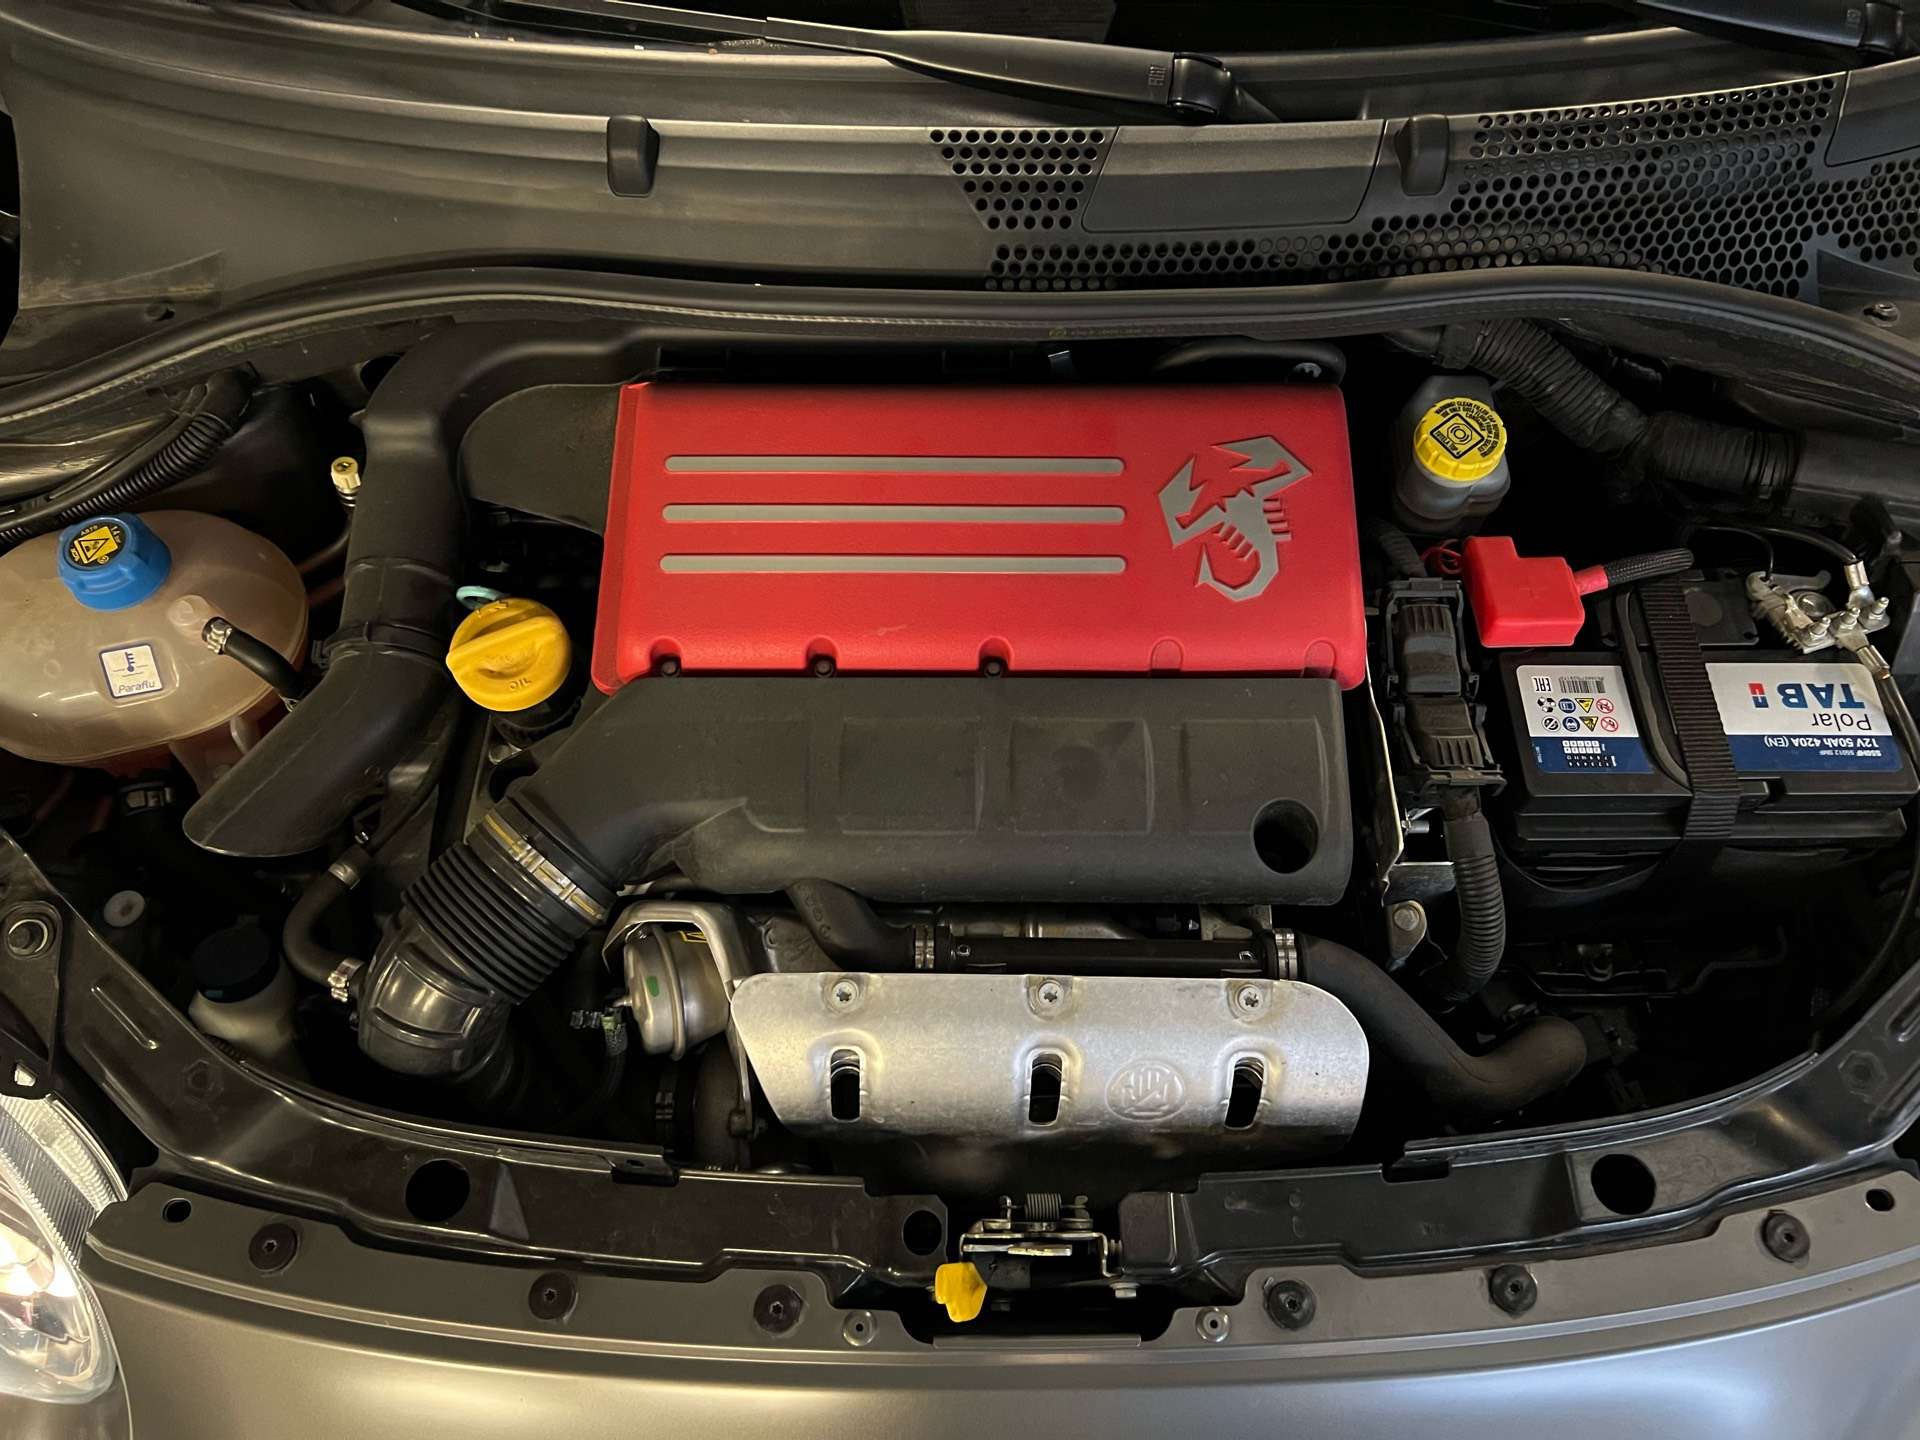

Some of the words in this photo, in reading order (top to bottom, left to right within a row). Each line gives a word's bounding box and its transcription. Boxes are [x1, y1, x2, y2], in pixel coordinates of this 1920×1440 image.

[509, 678, 531, 691] OIL
[1777, 683, 1866, 709] TAB
[1811, 713, 1872, 732] Polar
[1764, 736, 1789, 748] (EN)
[1791, 737, 1821, 748] 420A
[1824, 737, 1854, 748] 50Ah
[1856, 737, 1879, 748] 12V
